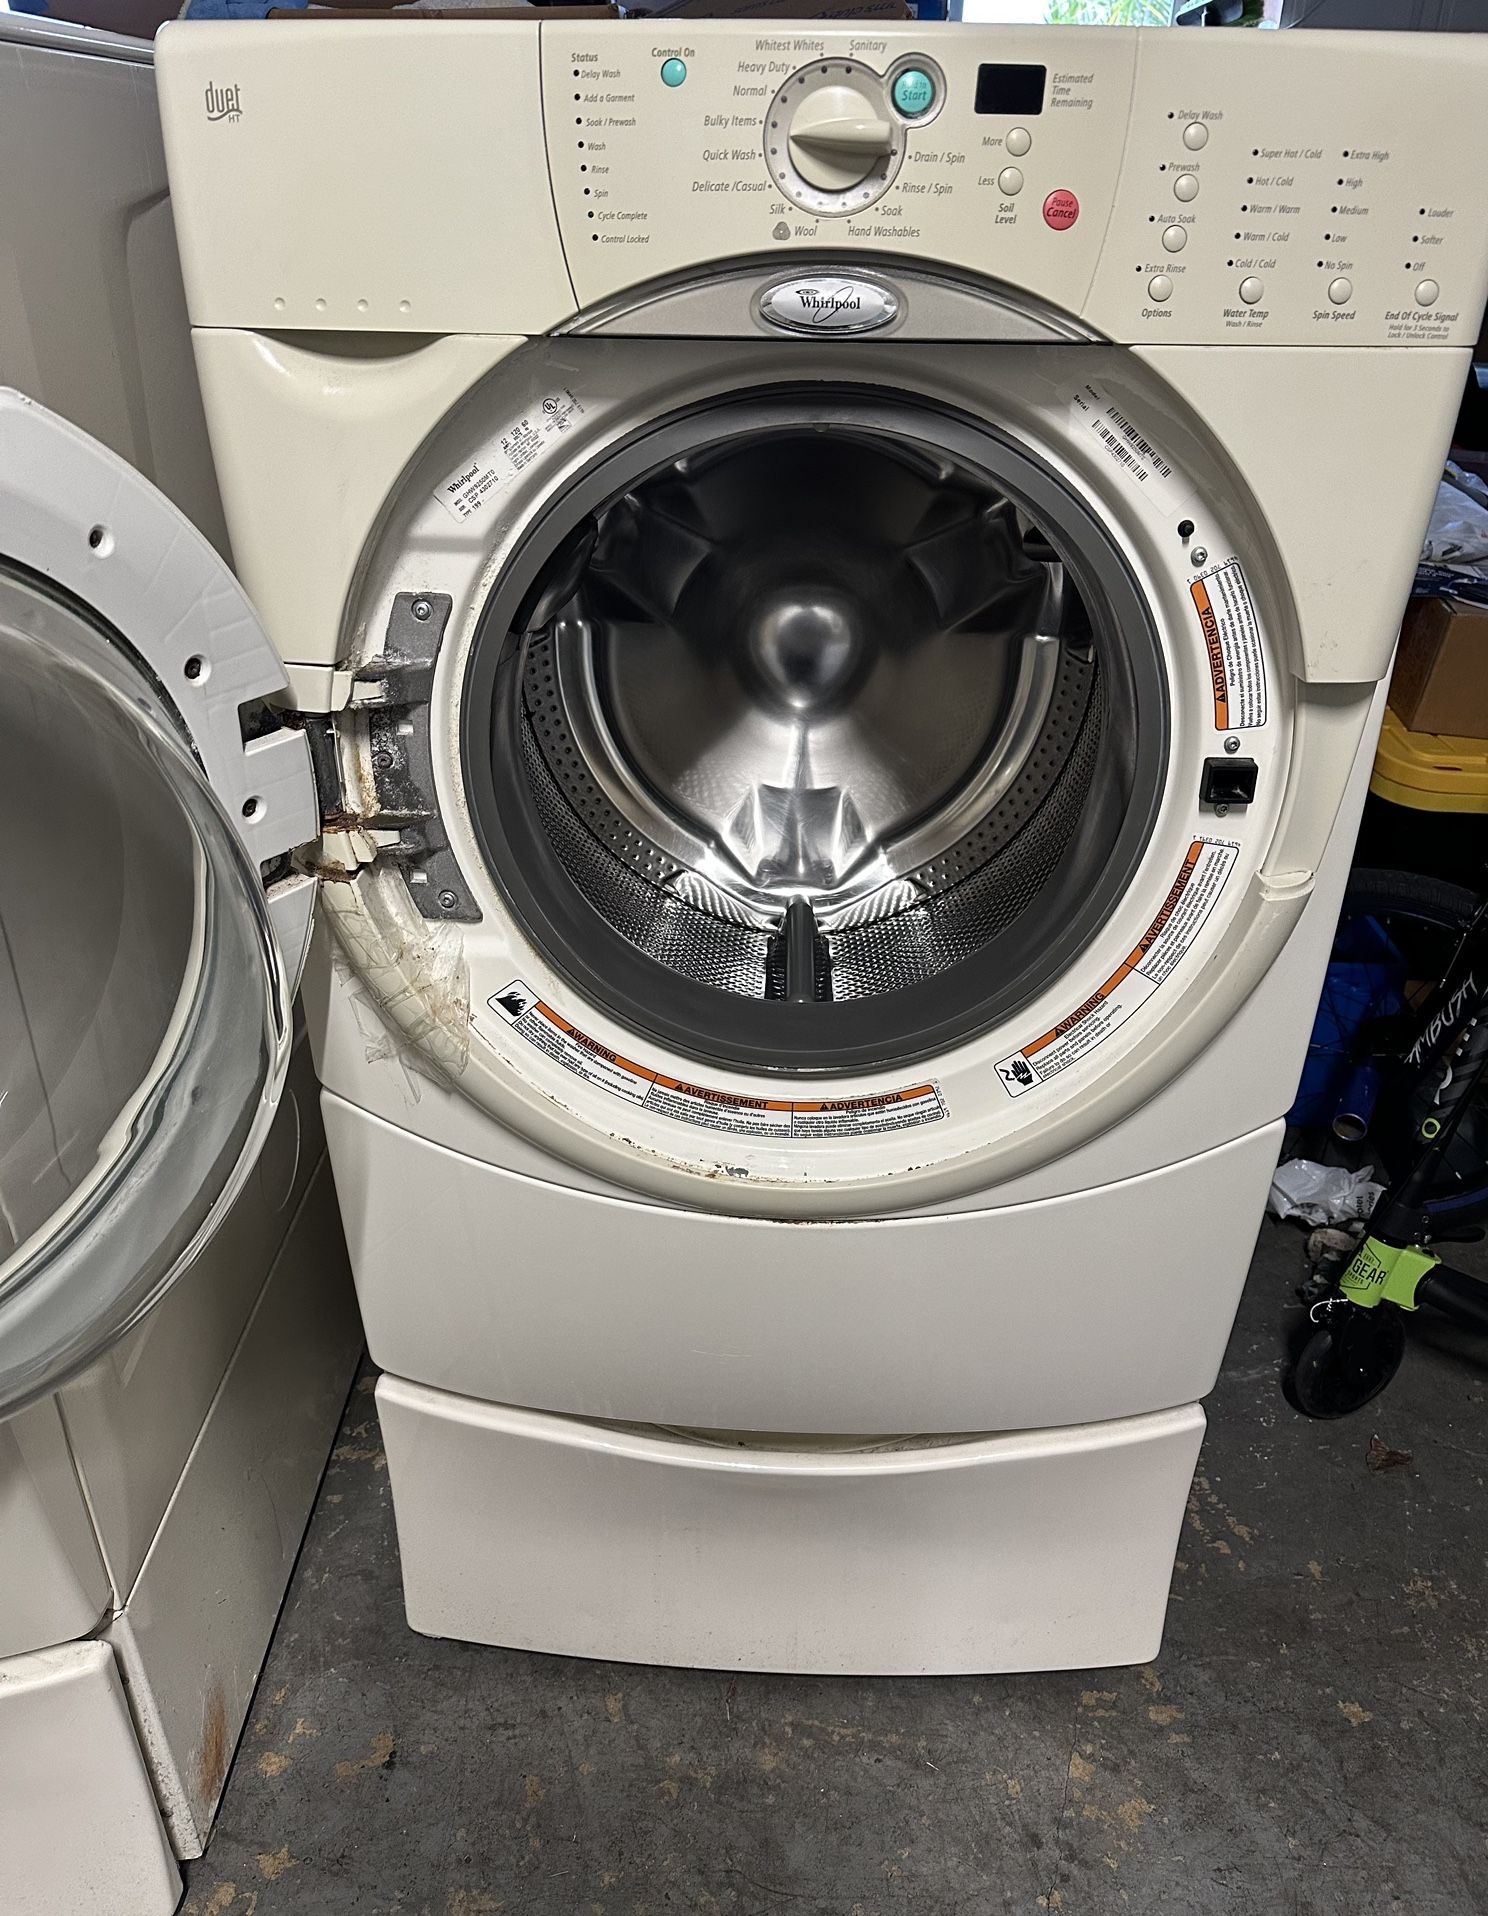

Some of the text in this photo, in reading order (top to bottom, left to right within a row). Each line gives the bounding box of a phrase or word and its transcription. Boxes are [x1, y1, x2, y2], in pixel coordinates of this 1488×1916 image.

[756, 39, 824, 51] Whitest Whites
[849, 39, 887, 54] Sanitary
[571, 53, 598, 63] Status
[652, 47, 695, 58] Control On
[737, 61, 790, 74] Heavy Duty
[581, 69, 620, 80] Delay Wash
[1053, 73, 1094, 83] Estimated
[733, 85, 768, 96] Normal
[902, 89, 927, 103] Start
[1052, 85, 1071, 95] Time
[205, 81, 243, 121] duet
[583, 94, 598, 103] Add
[605, 94, 635, 102] Garment
[1051, 97, 1093, 110] Remaining
[229, 115, 240, 123] HT
[586, 117, 636, 127] Soak / Prewash
[704, 115, 757, 128] Bulky Items
[1178, 110, 1223, 122] Delay Wash
[588, 142, 606, 151] Wash
[982, 136, 1003, 146] More
[703, 149, 756, 162] Quick Wash
[914, 151, 965, 165] Drain / Spin
[1260, 148, 1322, 160] Super Hot / Cold
[1350, 150, 1389, 162] Extra High
[591, 165, 609, 174] Rinse
[1168, 162, 1200, 172] Prewash
[692, 181, 767, 192] Delicate /Casual
[978, 176, 995, 186] Less
[1255, 176, 1294, 187] Hot / Cold
[1345, 178, 1363, 190] High
[593, 189, 608, 200] Spin
[902, 182, 952, 196] Rinse / Spin
[769, 203, 786, 214] Silk
[998, 203, 1015, 213] Soil
[1052, 197, 1073, 208] Pause
[880, 205, 903, 216] Soak
[1046, 207, 1076, 219] Cancel
[1250, 204, 1300, 215] Warm / Warm
[1339, 206, 1369, 215] Medium
[1428, 208, 1454, 218] Louder
[597, 210, 647, 222] Cycle Complete
[995, 214, 1017, 224] Level
[1157, 214, 1196, 225] Auto Soak
[795, 225, 817, 236] Wool
[848, 225, 920, 237] Hand Washables
[601, 235, 650, 243] Control Locked
[1244, 232, 1289, 242] Warm / Cold
[1332, 234, 1347, 242] Low
[1420, 235, 1443, 244] Softer
[1144, 264, 1186, 273] Extra Rinse
[1235, 259, 1276, 269] Cold / Cold
[1324, 260, 1353, 272] No Spin
[1413, 262, 1426, 271] Off
[800, 296, 861, 311] Whirlpool
[1141, 307, 1172, 319] Options
[1223, 309, 1269, 322] Water Temp
[1312, 310, 1356, 322] Spin Speed
[1385, 311, 1459, 323] End Of Cycle Signal
[1242, 320, 1245, 329] /
[1085, 384, 1101, 401] Model
[1073, 394, 1090, 412] Serial
[447, 465, 480, 495] Whirlpool
[1219, 618, 1229, 641] Eléctrico
[1201, 607, 1226, 694] ADVERTENCIA
[1224, 641, 1233, 660] Choque
[1228, 669, 1236, 686] Peligro
[1144, 859, 1195, 944] AVERTISSEMENT
[1159, 922, 1173, 938] Risque
[1174, 905, 1183, 917] choc
[1180, 882, 1196, 905] électrique
[1061, 992, 1105, 1031] WARNING
[1404, 970, 1477, 1063] AMBUSH
[1064, 1000, 1109, 1040] Electrical Shock Hazard
[572, 1031, 617, 1063] WARNING
[1032, 1016, 1101, 1067] Disconnect power before servicing.
[685, 1086, 768, 1110] AVERTISSEMENT
[830, 1094, 902, 1111] ADVERTENCIA
[1352, 1258, 1387, 1285] GEAR
